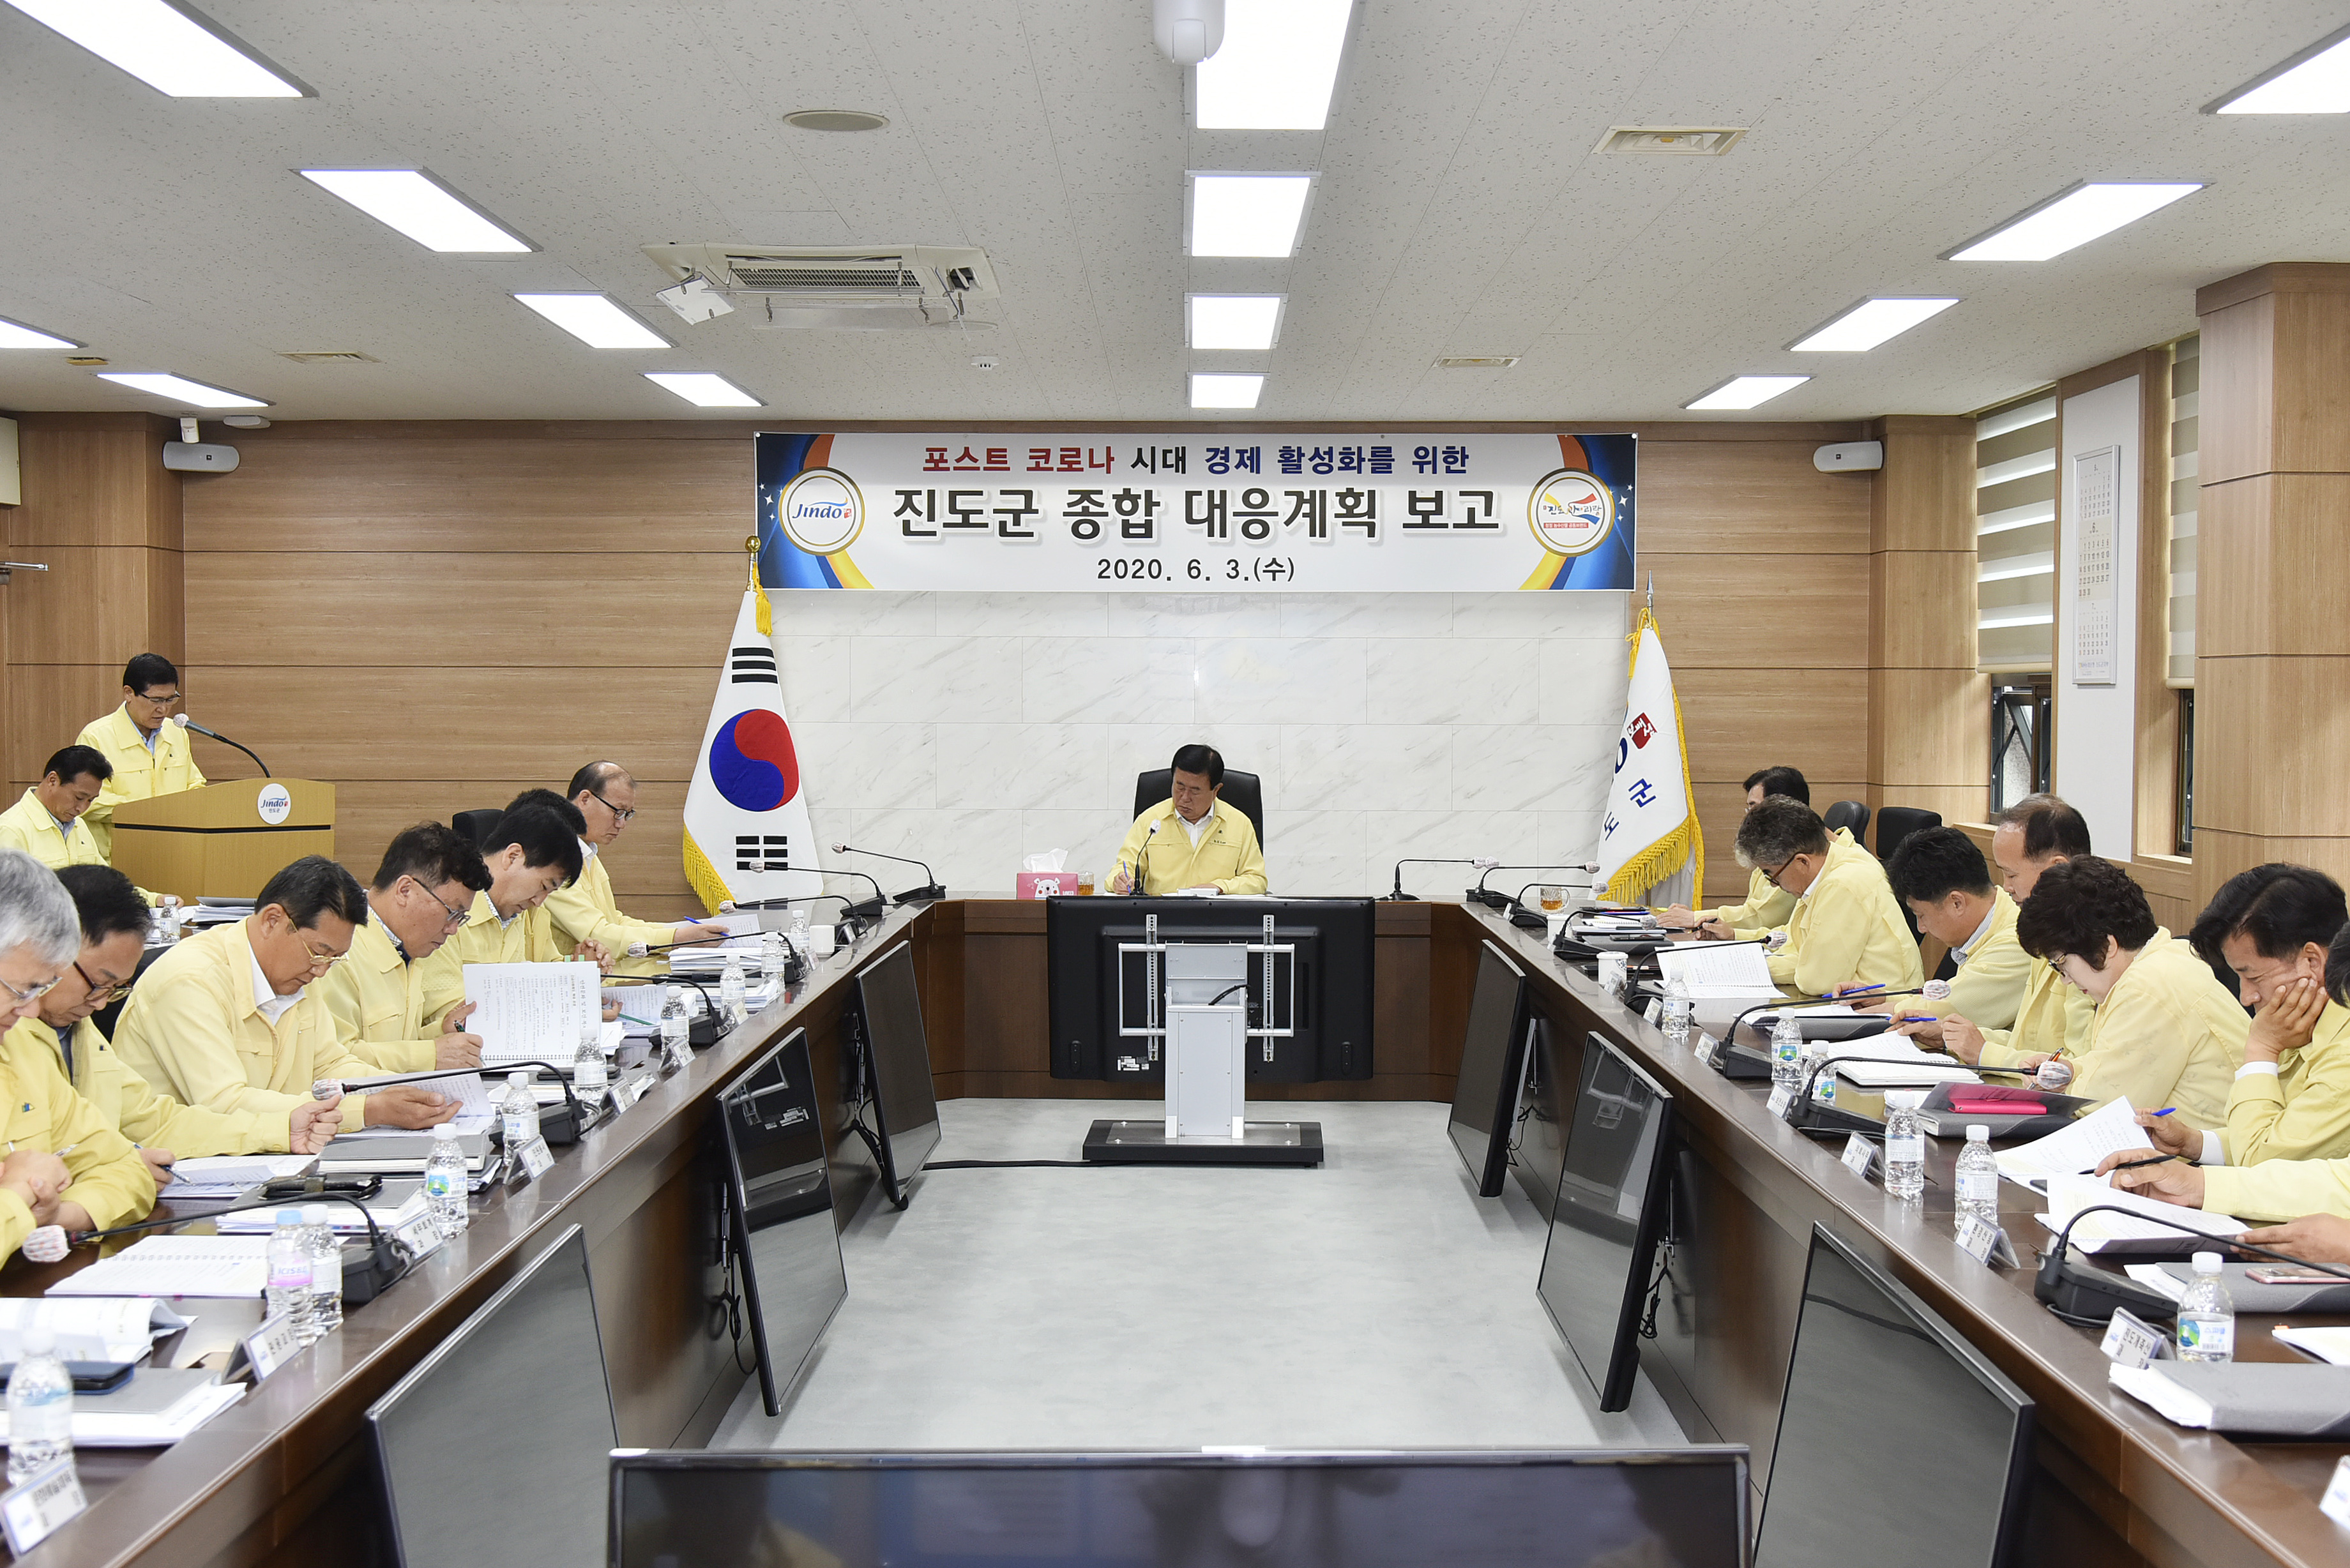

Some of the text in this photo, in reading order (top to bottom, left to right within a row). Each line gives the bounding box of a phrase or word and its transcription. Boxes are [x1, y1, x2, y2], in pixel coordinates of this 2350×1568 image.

[922, 446, 1469, 475] 포스트 코로나 시대 경제 활성화를 위한
[792, 504, 842, 518] Jindo
[894, 487, 1499, 540] 진도군 종합 대응계획 보고
[1097, 556, 1295, 583] 2020. 6. 3.(수)
[261, 799, 284, 808] Jindo
[2123, 1327, 2151, 1355] 진도개축산
